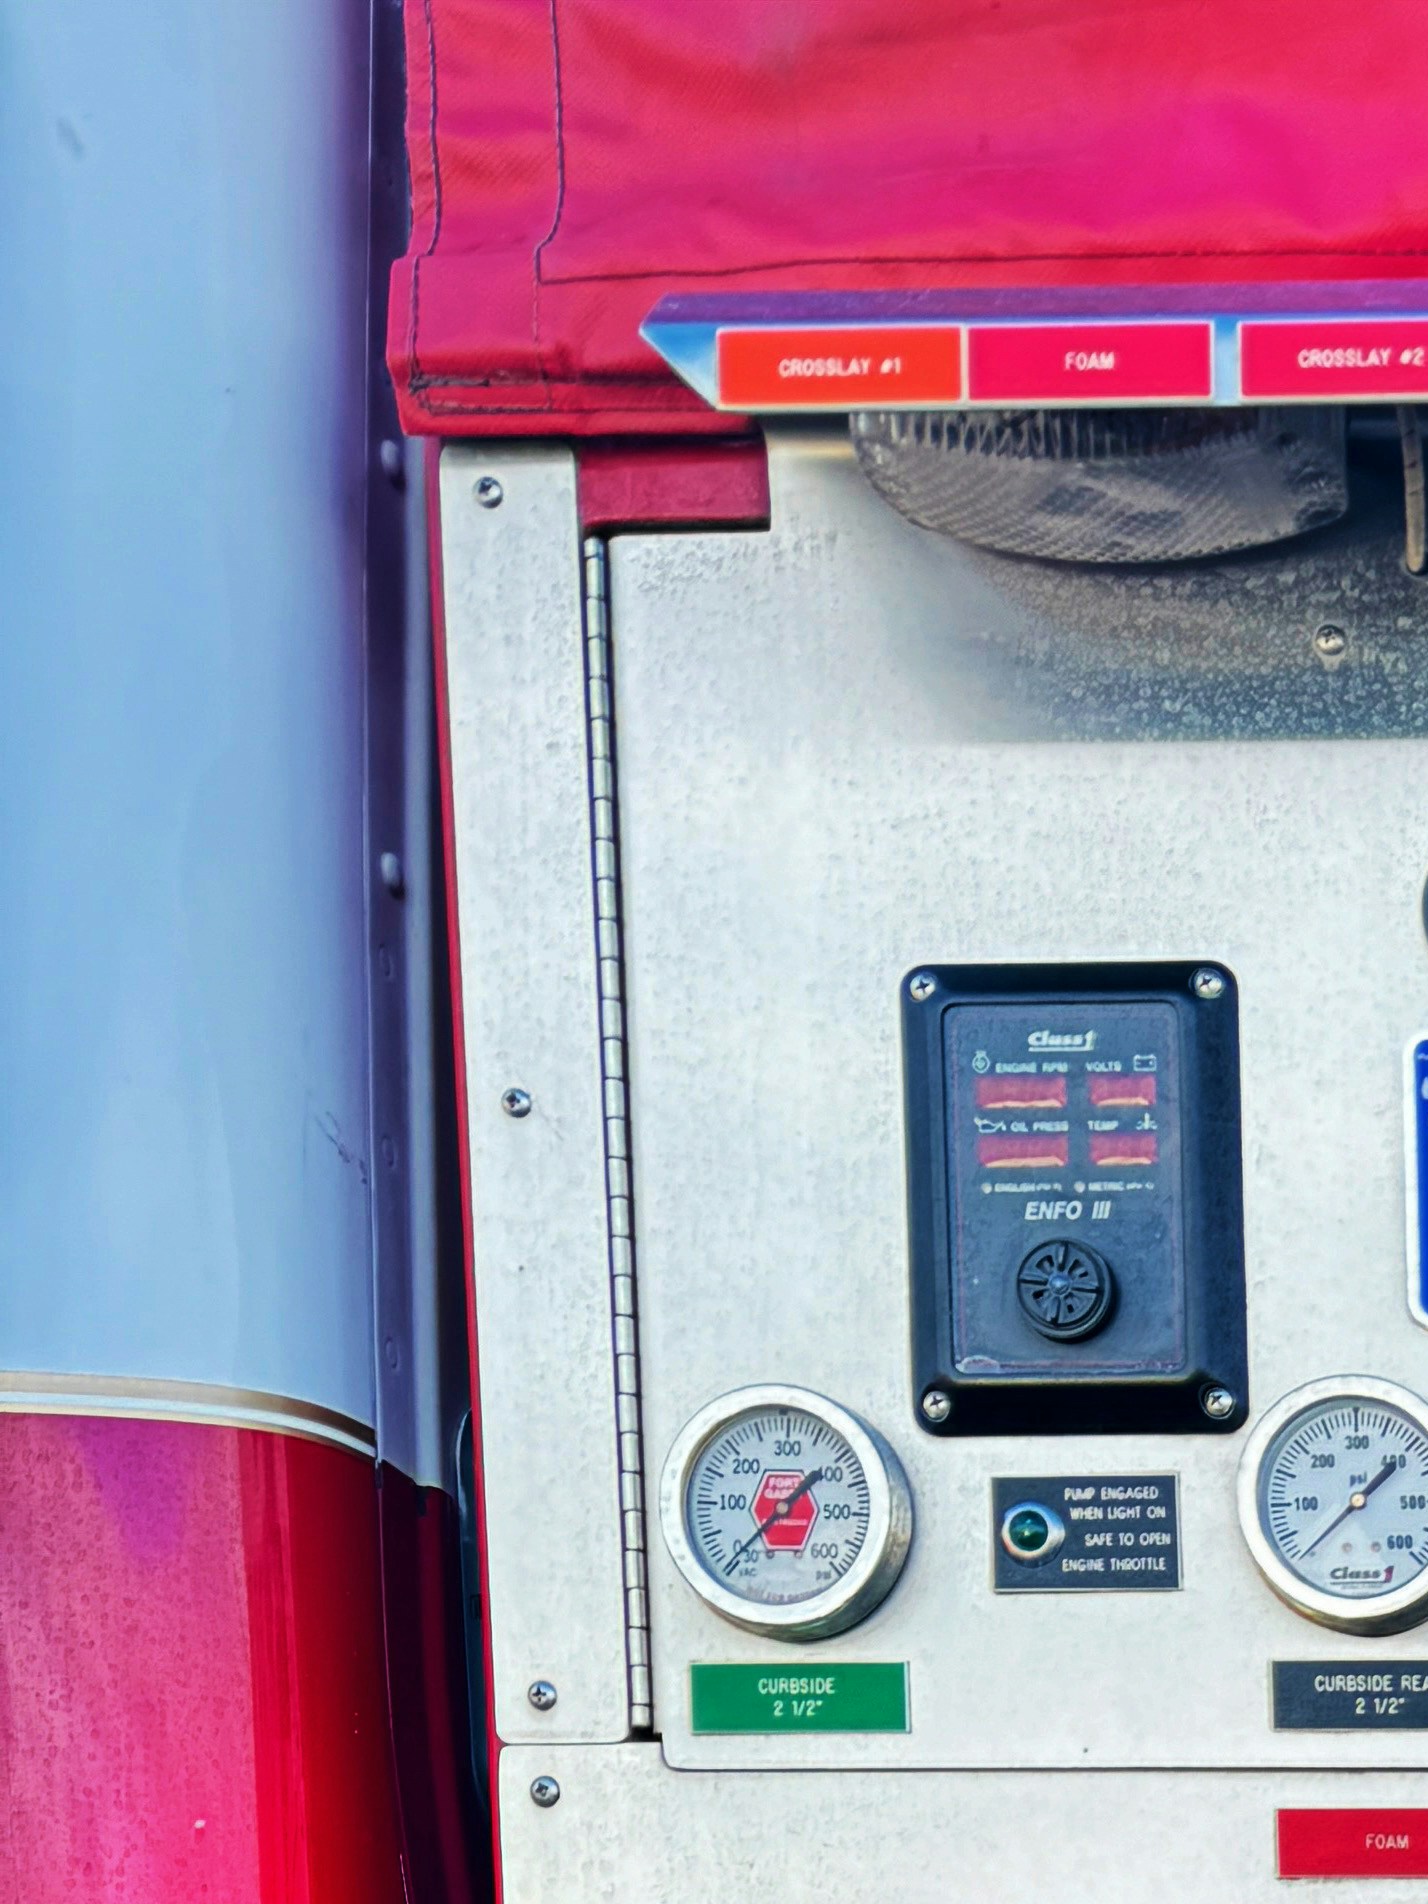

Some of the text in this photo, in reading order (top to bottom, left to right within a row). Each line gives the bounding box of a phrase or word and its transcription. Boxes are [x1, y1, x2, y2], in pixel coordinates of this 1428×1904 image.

[1064, 351, 1115, 371] FOAM
[1298, 346, 1425, 367] CROSSLAY #2
[778, 357, 901, 377] CROSSLAY #1
[1024, 1202, 1111, 1220] ENFO III
[758, 1679, 835, 1694] CURBSIDE
[1314, 1675, 1393, 1692] CURBSIDE
[773, 1701, 822, 1715] 2 1/2"
[1355, 1698, 1406, 1713] 2 1/2"
[1365, 1833, 1409, 1849] FOAM
